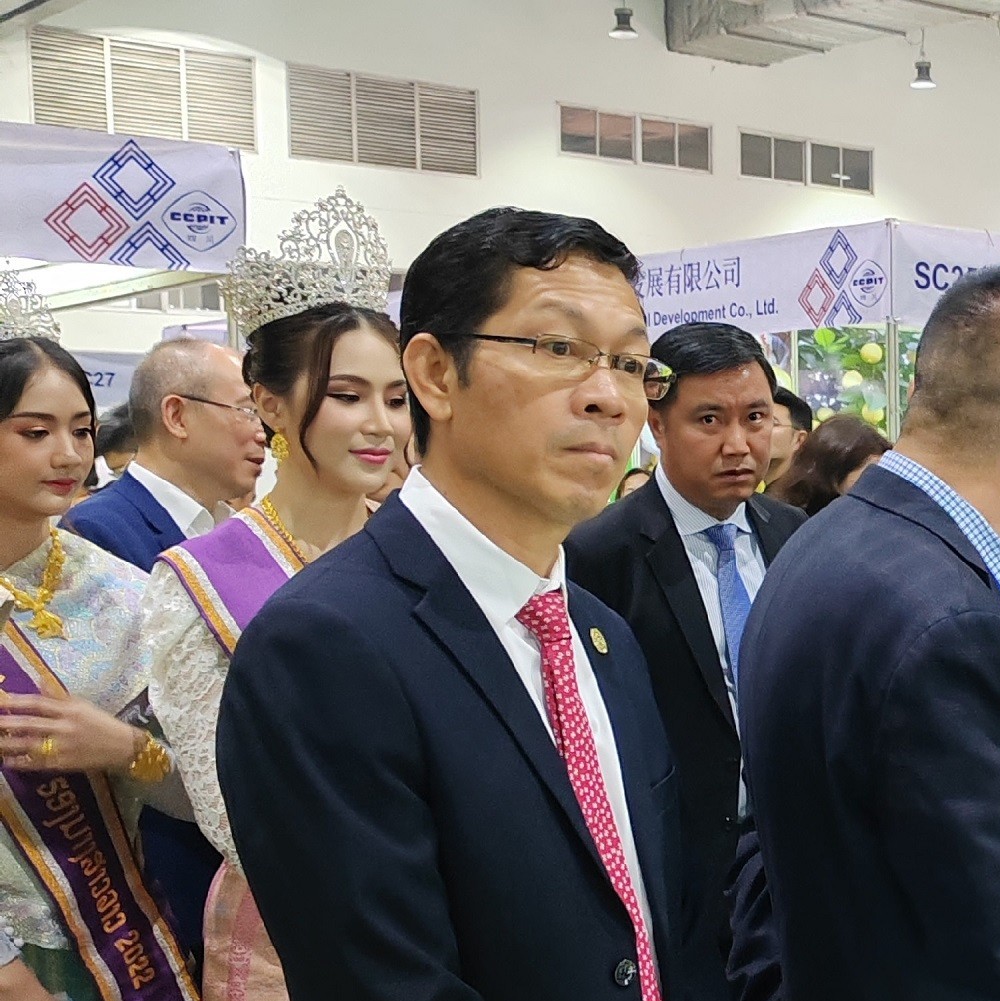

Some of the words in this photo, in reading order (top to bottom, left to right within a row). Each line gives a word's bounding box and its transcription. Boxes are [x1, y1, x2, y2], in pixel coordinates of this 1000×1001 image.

[170, 212, 229, 225] CCPIT
[914, 261, 978, 291] SC
[654, 306, 727, 327] Development
[756, 298, 779, 316] Ltd.
[113, 929, 156, 990] 2022
